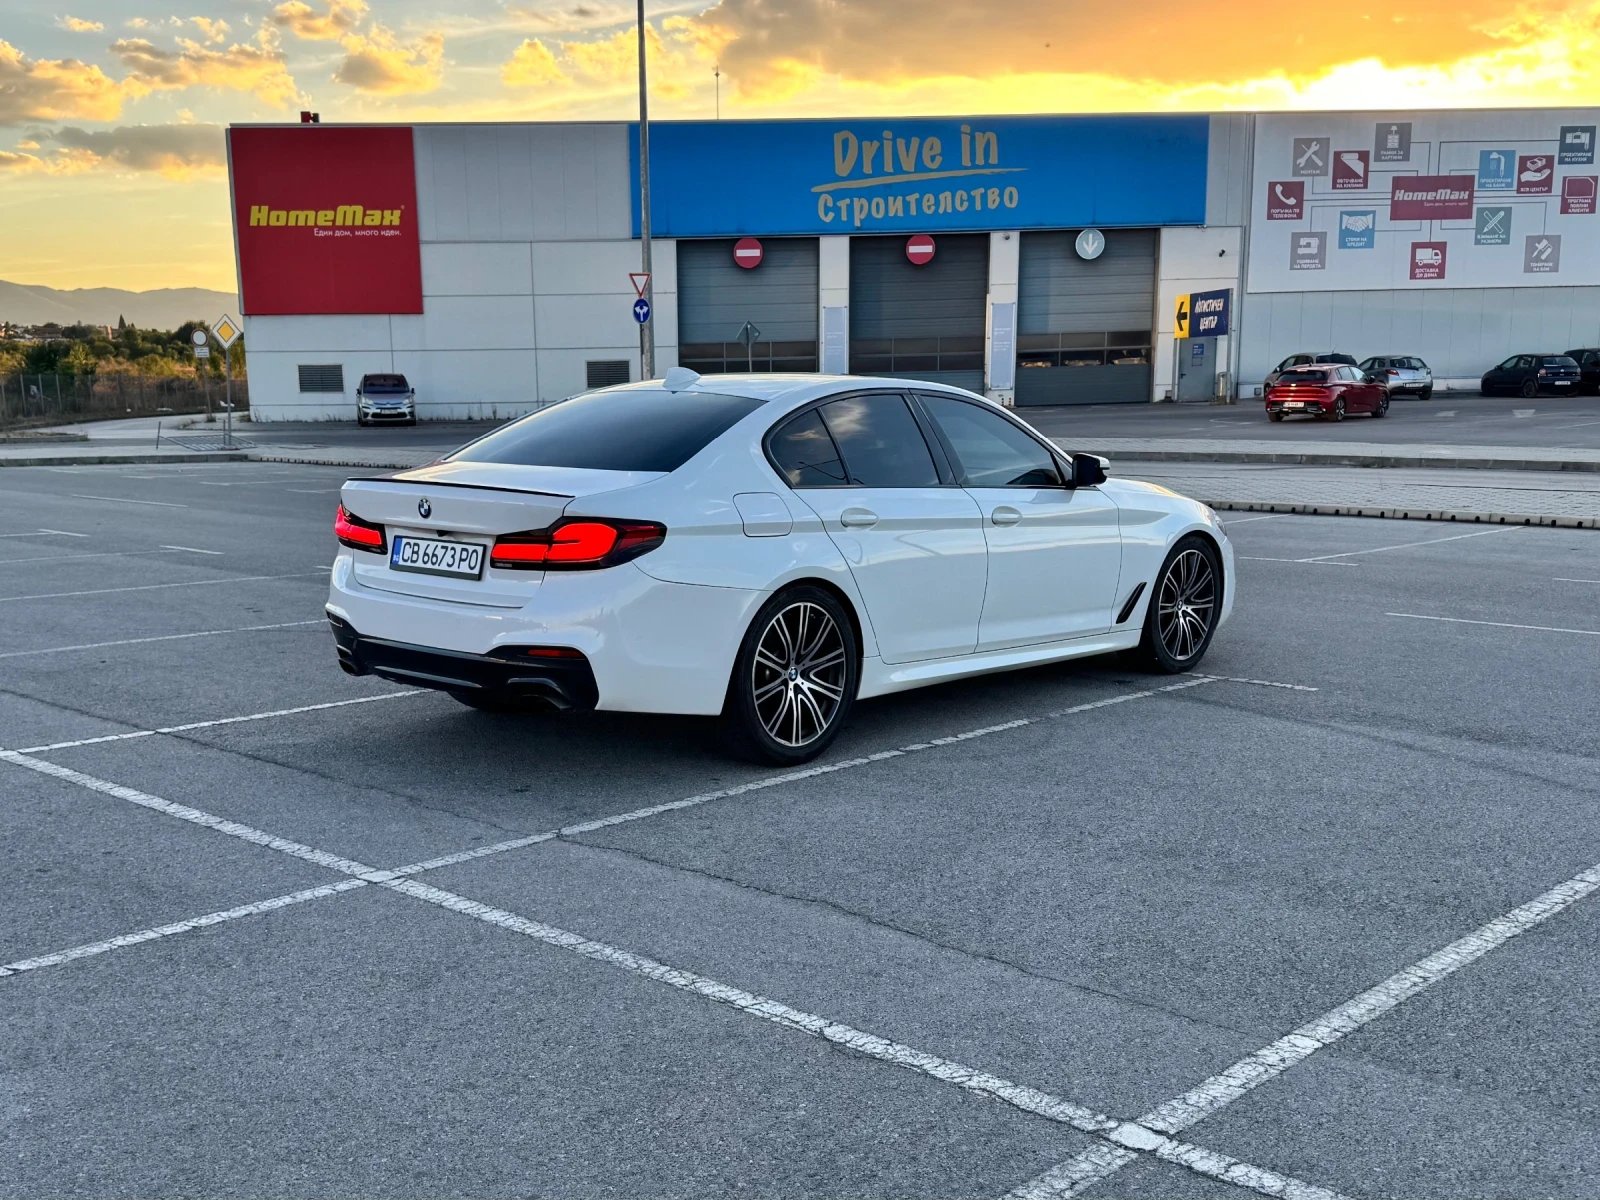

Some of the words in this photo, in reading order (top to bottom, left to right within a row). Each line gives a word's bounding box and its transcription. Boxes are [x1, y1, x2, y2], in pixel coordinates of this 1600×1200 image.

[833, 130, 943, 177] Drive
[960, 124, 998, 167] in
[1394, 189, 1469, 201] HomeMax
[817, 186, 1019, 227] Строителство
[249, 205, 402, 227] HomeMax
[314, 228, 333, 237] Един
[334, 229, 353, 238] дом,
[355, 229, 379, 237] много
[380, 229, 402, 237] идеи.
[1195, 297, 1224, 314] ЛОГИСТИЧЕН
[1199, 315, 1218, 333] ЦЕНТЪР
